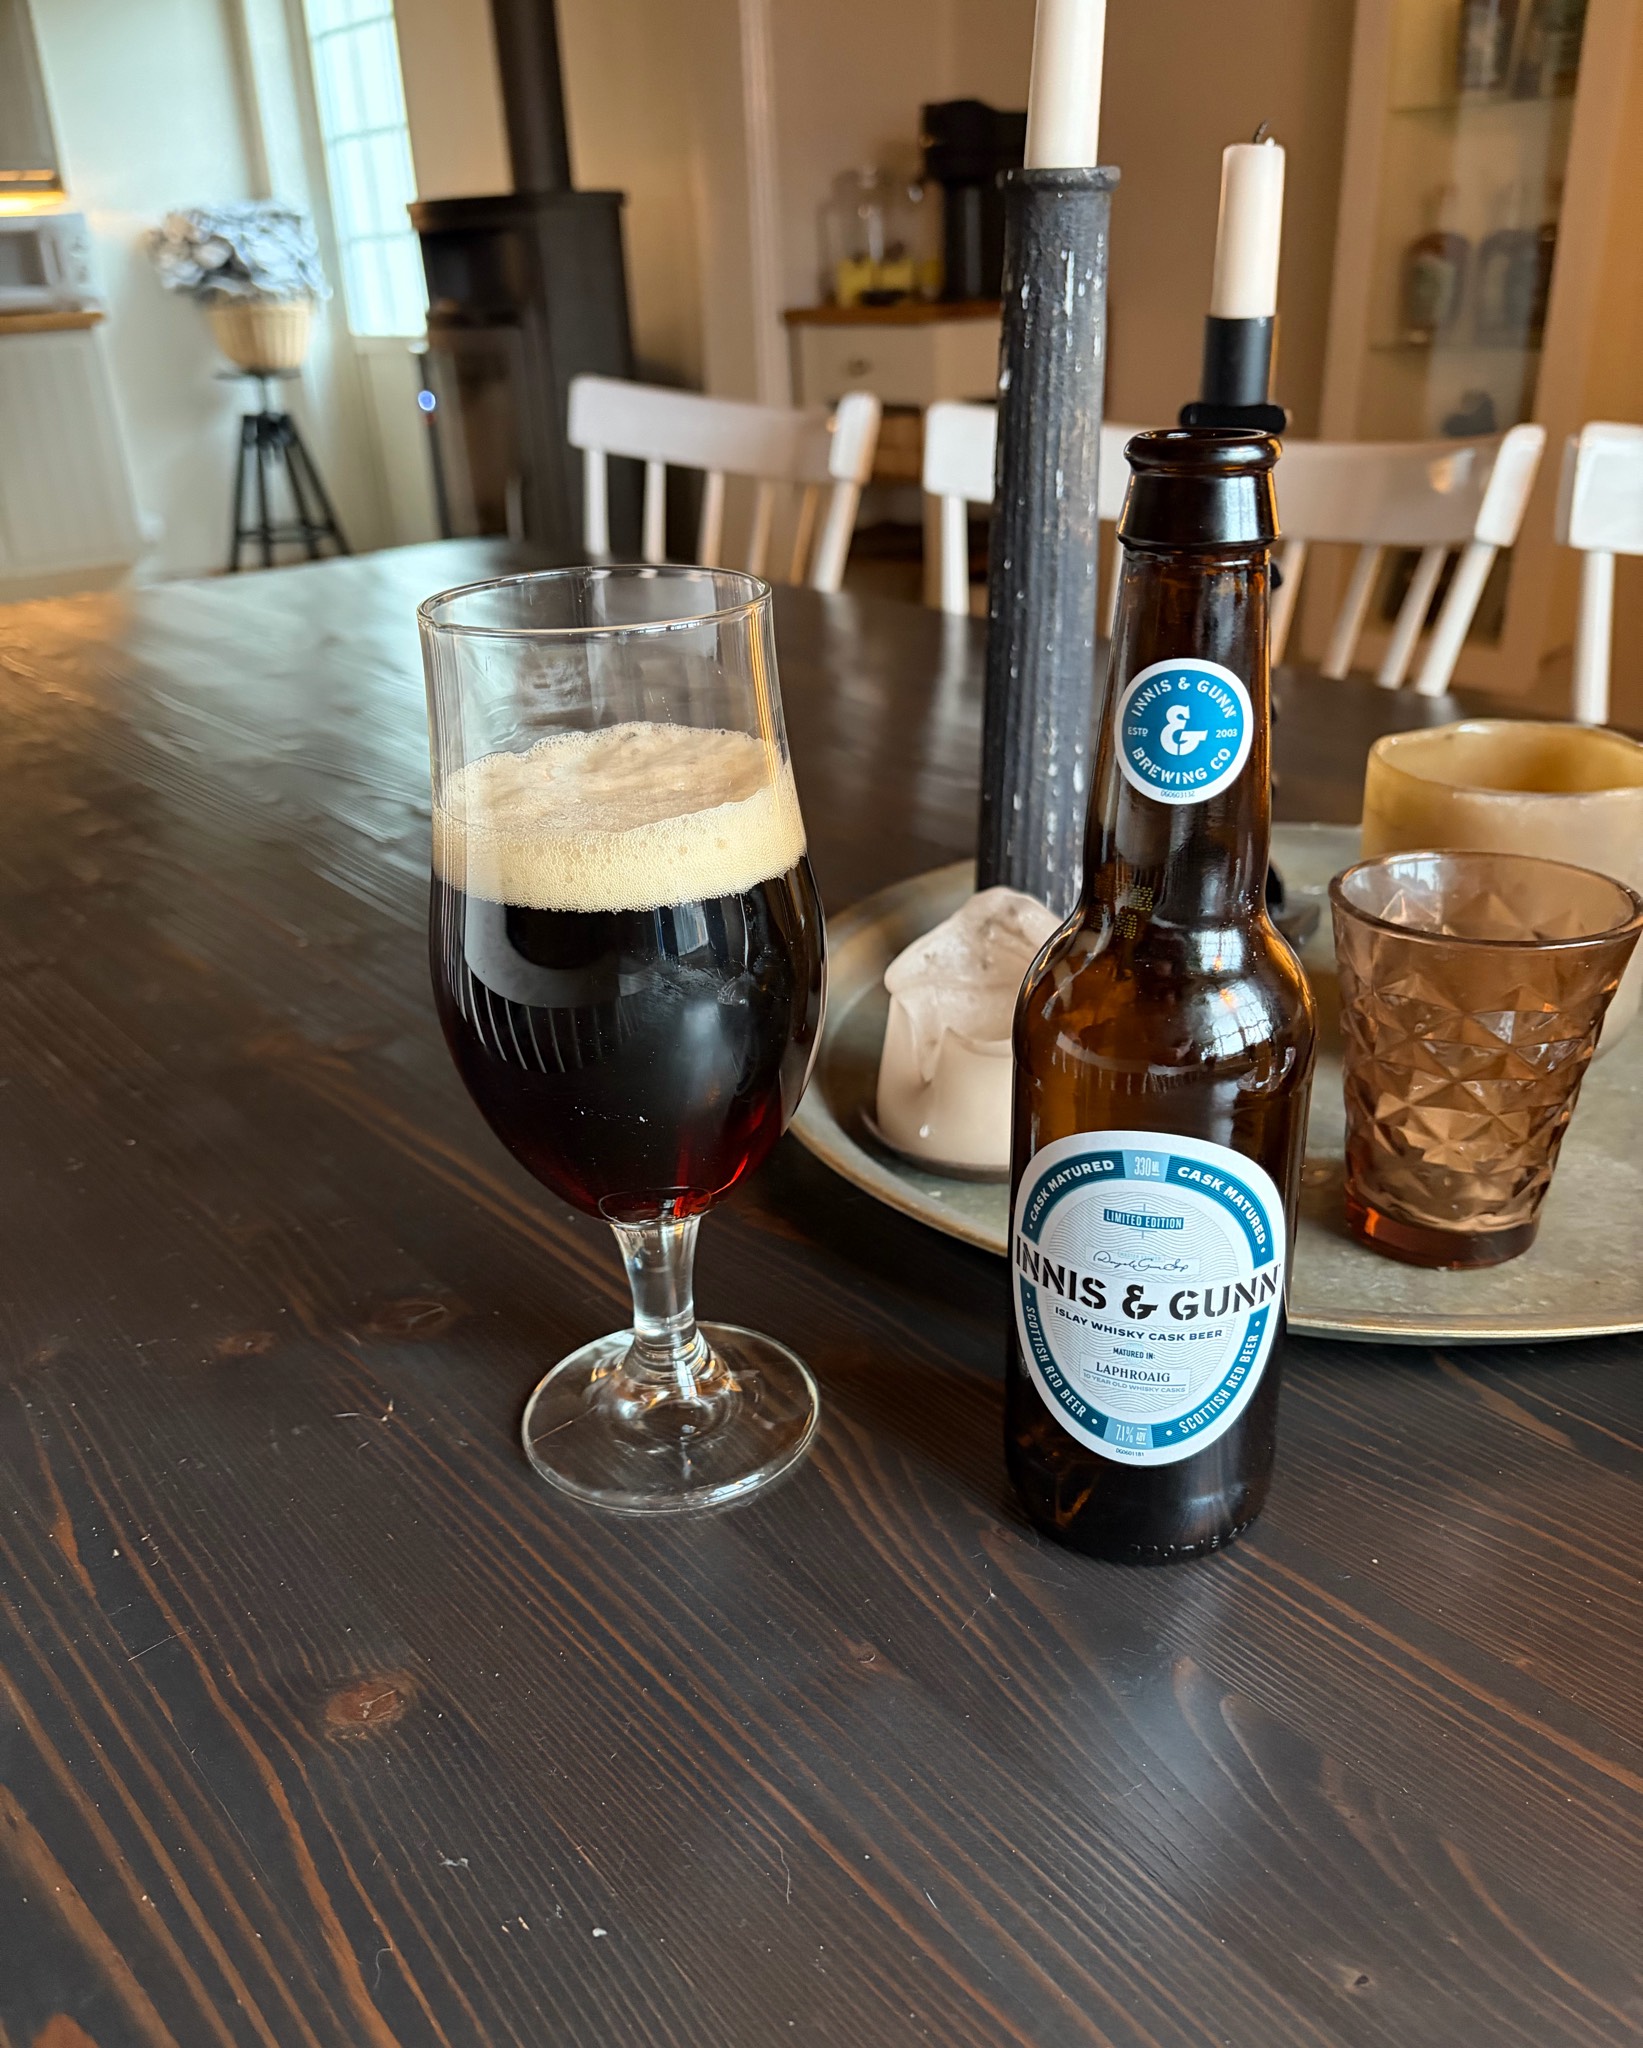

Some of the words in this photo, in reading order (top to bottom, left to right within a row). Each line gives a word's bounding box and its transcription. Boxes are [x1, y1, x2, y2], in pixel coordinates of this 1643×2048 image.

[1131, 679, 1172, 718] INNIS
[1178, 676, 1190, 690] &
[1197, 679, 1237, 719] GUNN
[1128, 726, 1148, 737] ESTD
[1160, 704, 1209, 756] &
[1215, 728, 1237, 738] 2003
[1132, 747, 1208, 785] BREWING
[1210, 748, 1231, 770] CO
[1030, 1187, 1050, 1222] CASK
[1047, 1160, 1115, 1192] MATURED
[1177, 1166, 1225, 1191] CASK
[1223, 1185, 1266, 1245] MATURED
[1106, 1210, 1142, 1226] LIMITED
[1145, 1216, 1182, 1229] EDITION
[1016, 1235, 1107, 1309] INNIS
[1122, 1284, 1158, 1320] &
[1169, 1263, 1280, 1320] GUNN
[1055, 1306, 1089, 1326] ISLAY
[1091, 1320, 1145, 1339] WHISKY
[1148, 1332, 1186, 1342] CASK
[1189, 1329, 1223, 1341] BEER
[1026, 1305, 1050, 1362] SCOTTISH
[1044, 1365, 1063, 1388] RED
[1060, 1388, 1087, 1417] BEER
[1113, 1347, 1144, 1359] MATURED
[1092, 1374, 1112, 1386] YEAR
[1112, 1381, 1128, 1389] OLD
[1129, 1384, 1160, 1393] WHISKY
[1096, 1361, 1171, 1383] LAPHROAIG
[1179, 1388, 1231, 1434] SCOTTISH
[1226, 1366, 1246, 1389] RED
[1239, 1334, 1260, 1363] BEER
[1116, 1424, 1134, 1443] 7.1%
